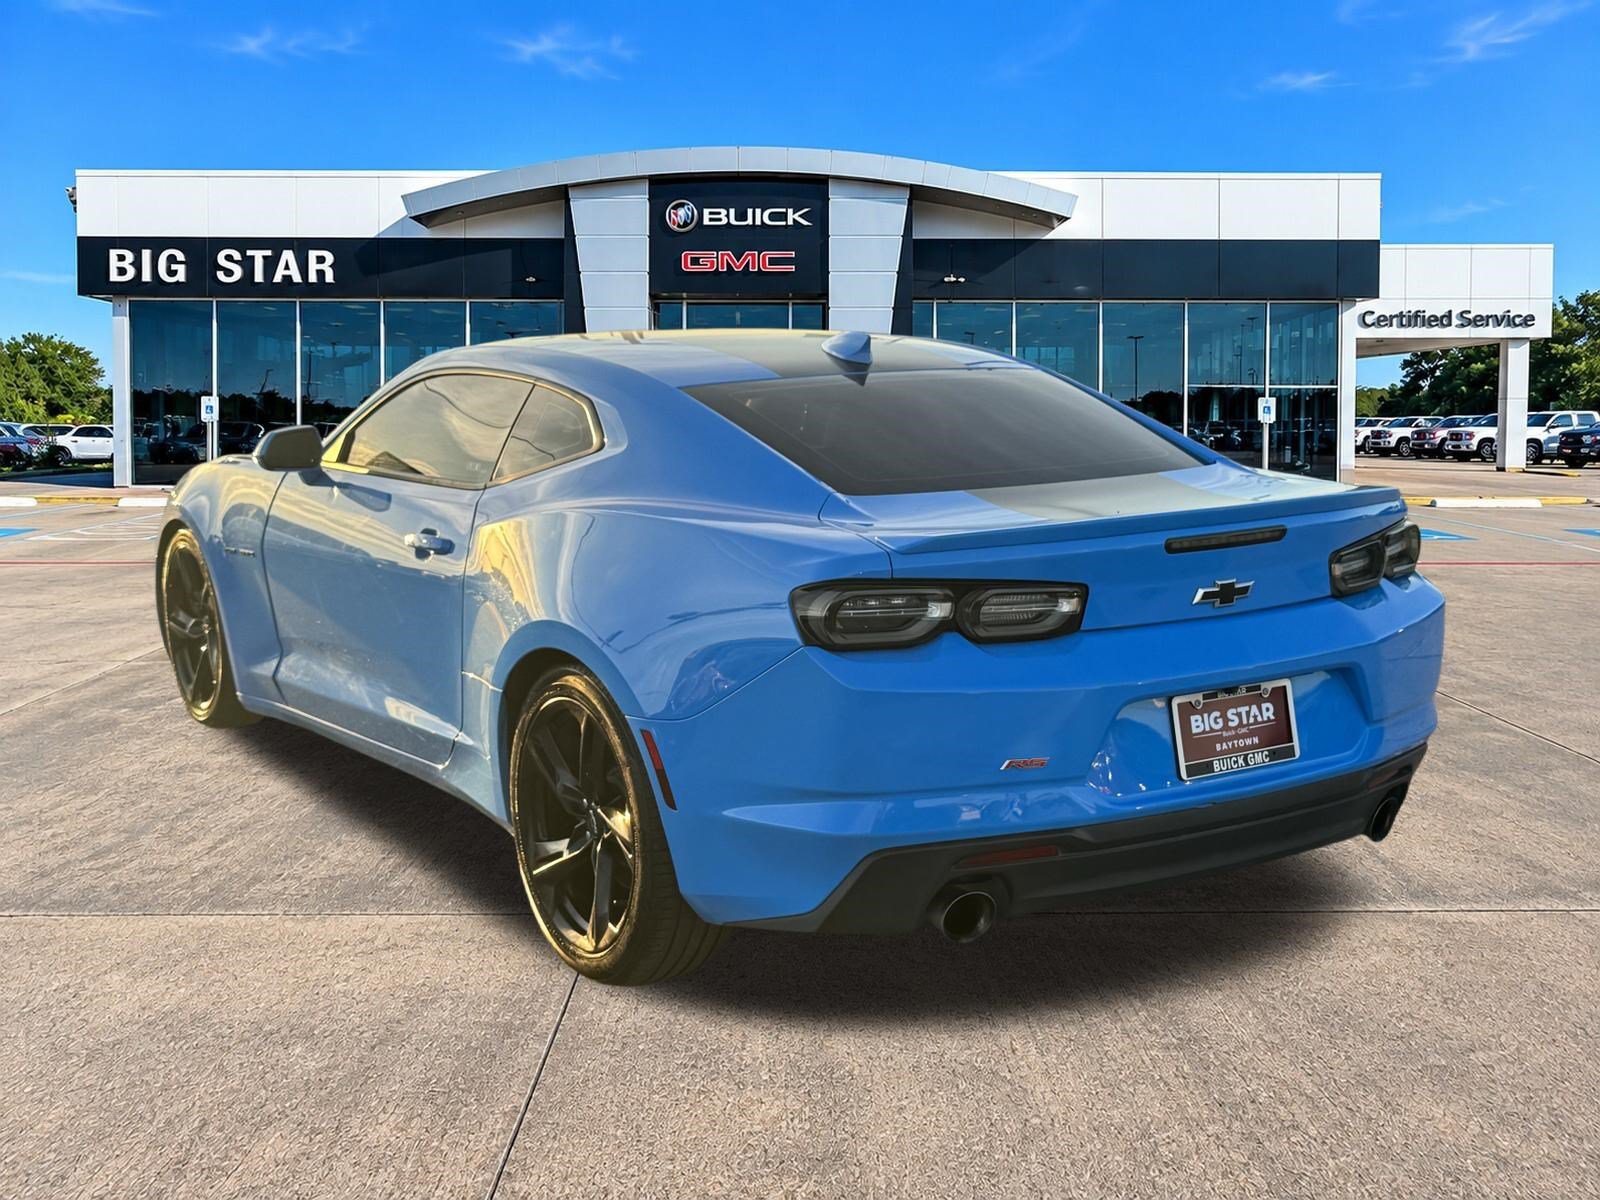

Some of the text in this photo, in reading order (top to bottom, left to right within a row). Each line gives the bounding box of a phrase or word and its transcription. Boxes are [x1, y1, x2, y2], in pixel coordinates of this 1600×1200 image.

[703, 208, 813, 226] BUICK
[108, 248, 336, 283] BIG STAR
[681, 250, 796, 272] GMC
[1359, 309, 1536, 328] Certified Service
[1190, 702, 1275, 734] BIG STAR
[1215, 736, 1259, 752] BAYTOWN
[1213, 750, 1270, 772] BUICK GMC
